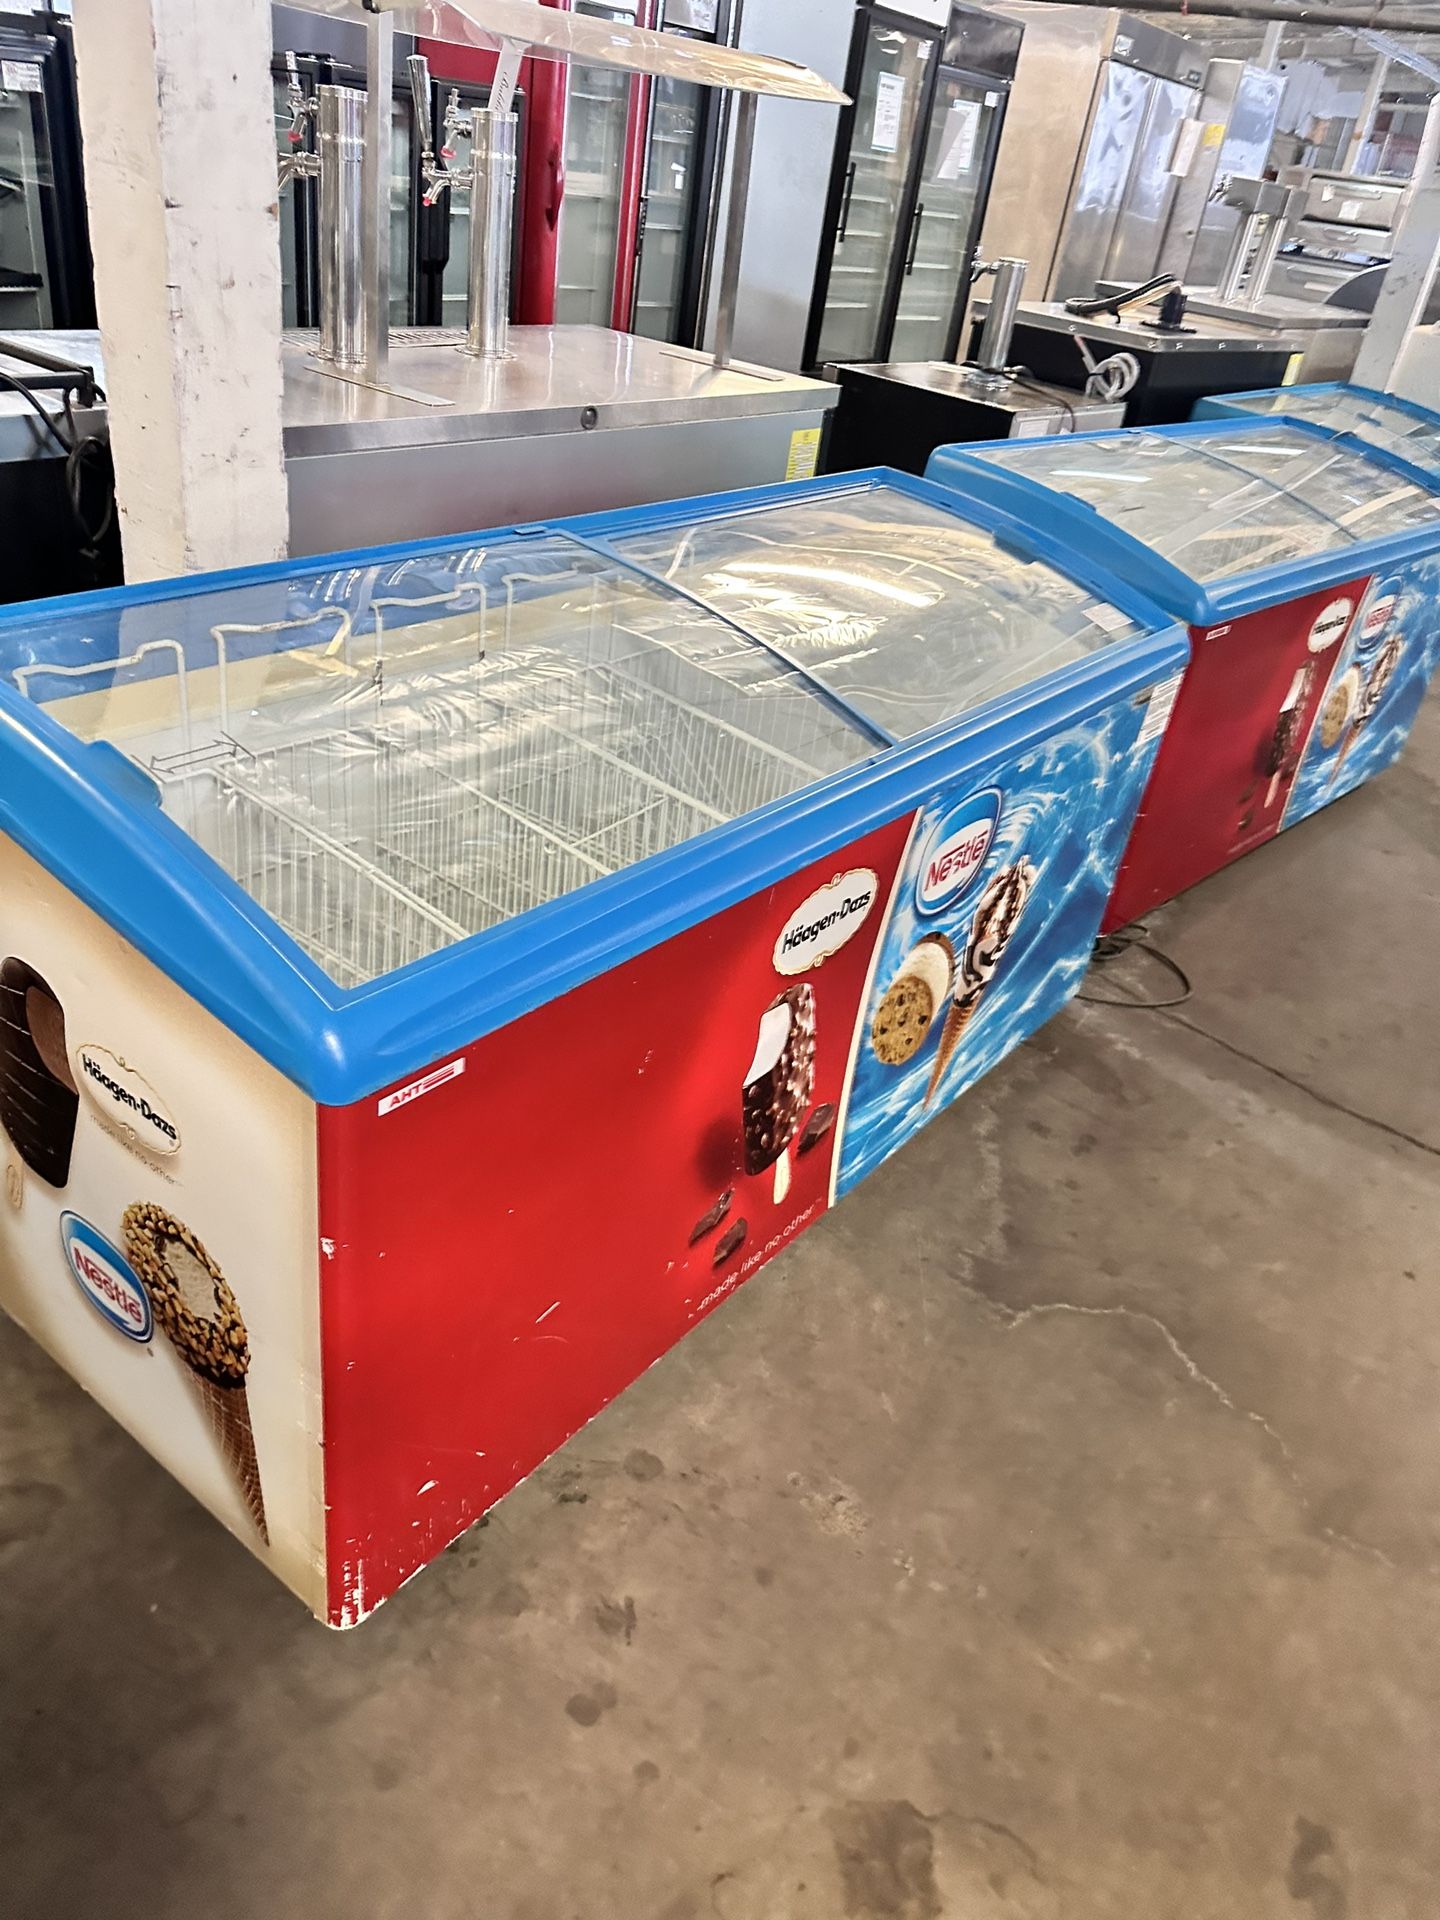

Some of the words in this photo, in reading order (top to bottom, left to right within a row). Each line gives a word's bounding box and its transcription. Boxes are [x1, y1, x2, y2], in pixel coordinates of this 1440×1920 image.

[923, 830, 988, 892] Nestlé
[781, 890, 872, 955] Häagen-Dazs
[81, 1052, 177, 1140] Häagen-Dazs
[388, 1082, 423, 1108] AHT
[72, 1246, 143, 1324] Nestlé
[697, 1271, 739, 1311] made
[740, 1250, 762, 1273] like
[764, 1234, 782, 1253] no
